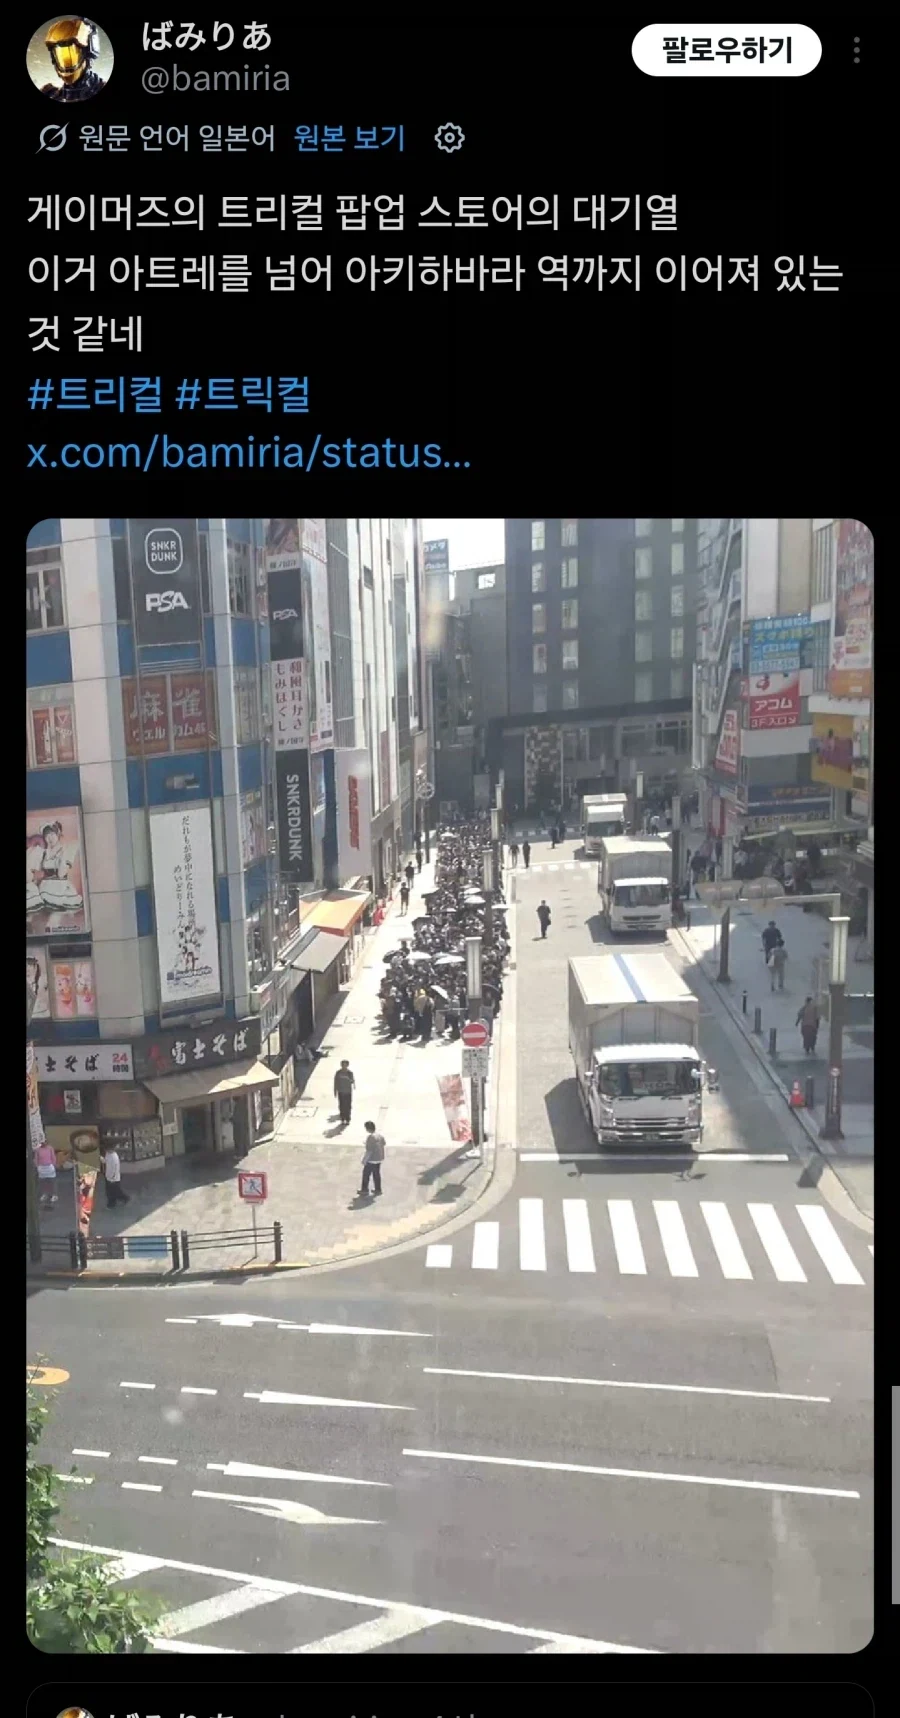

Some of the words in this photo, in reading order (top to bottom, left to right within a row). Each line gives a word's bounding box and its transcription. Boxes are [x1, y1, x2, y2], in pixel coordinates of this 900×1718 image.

[151, 541, 177, 550] SNKR
[151, 552, 177, 562] DUNK
[145, 591, 189, 612] PSA
[273, 609, 298, 621] PSA
[130, 688, 203, 723] 麻雀
[754, 697, 793, 712] アコム
[286, 774, 303, 861] SNKRDUNK
[172, 1028, 249, 1065] 富士そば
[36, 1053, 99, 1073] 士そば
[112, 1053, 129, 1063] 24
